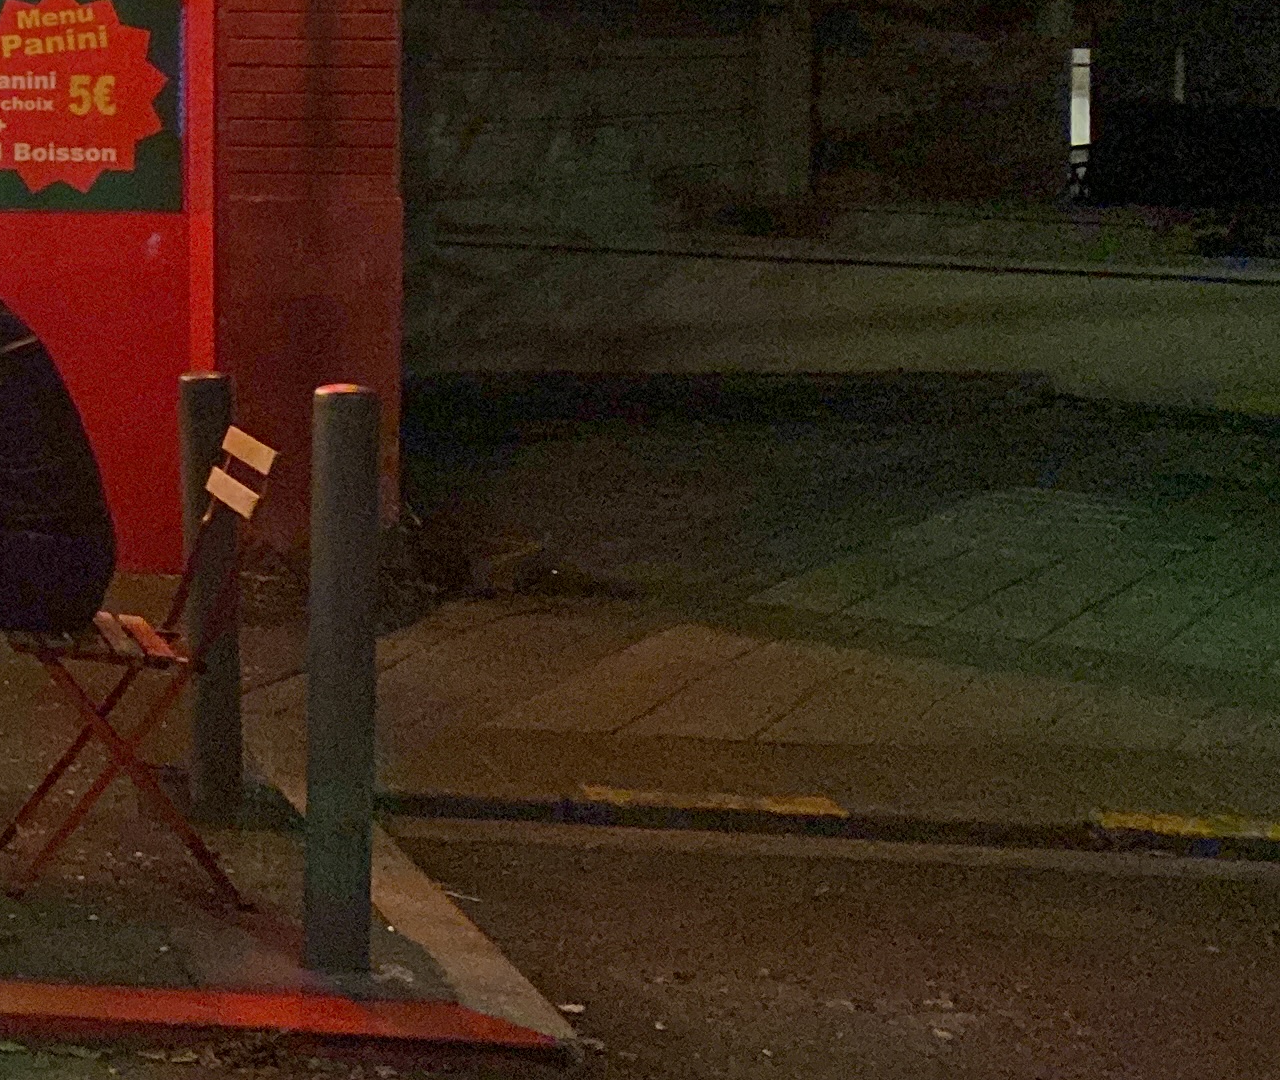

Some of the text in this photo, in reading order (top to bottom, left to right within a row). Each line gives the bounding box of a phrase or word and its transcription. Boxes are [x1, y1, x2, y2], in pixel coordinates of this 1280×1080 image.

[16, 7, 94, 30] Menu
[0, 25, 109, 59] Panini
[0, 96, 54, 111] choix
[68, 74, 117, 116] 5€
[13, 141, 118, 162] Boisson
